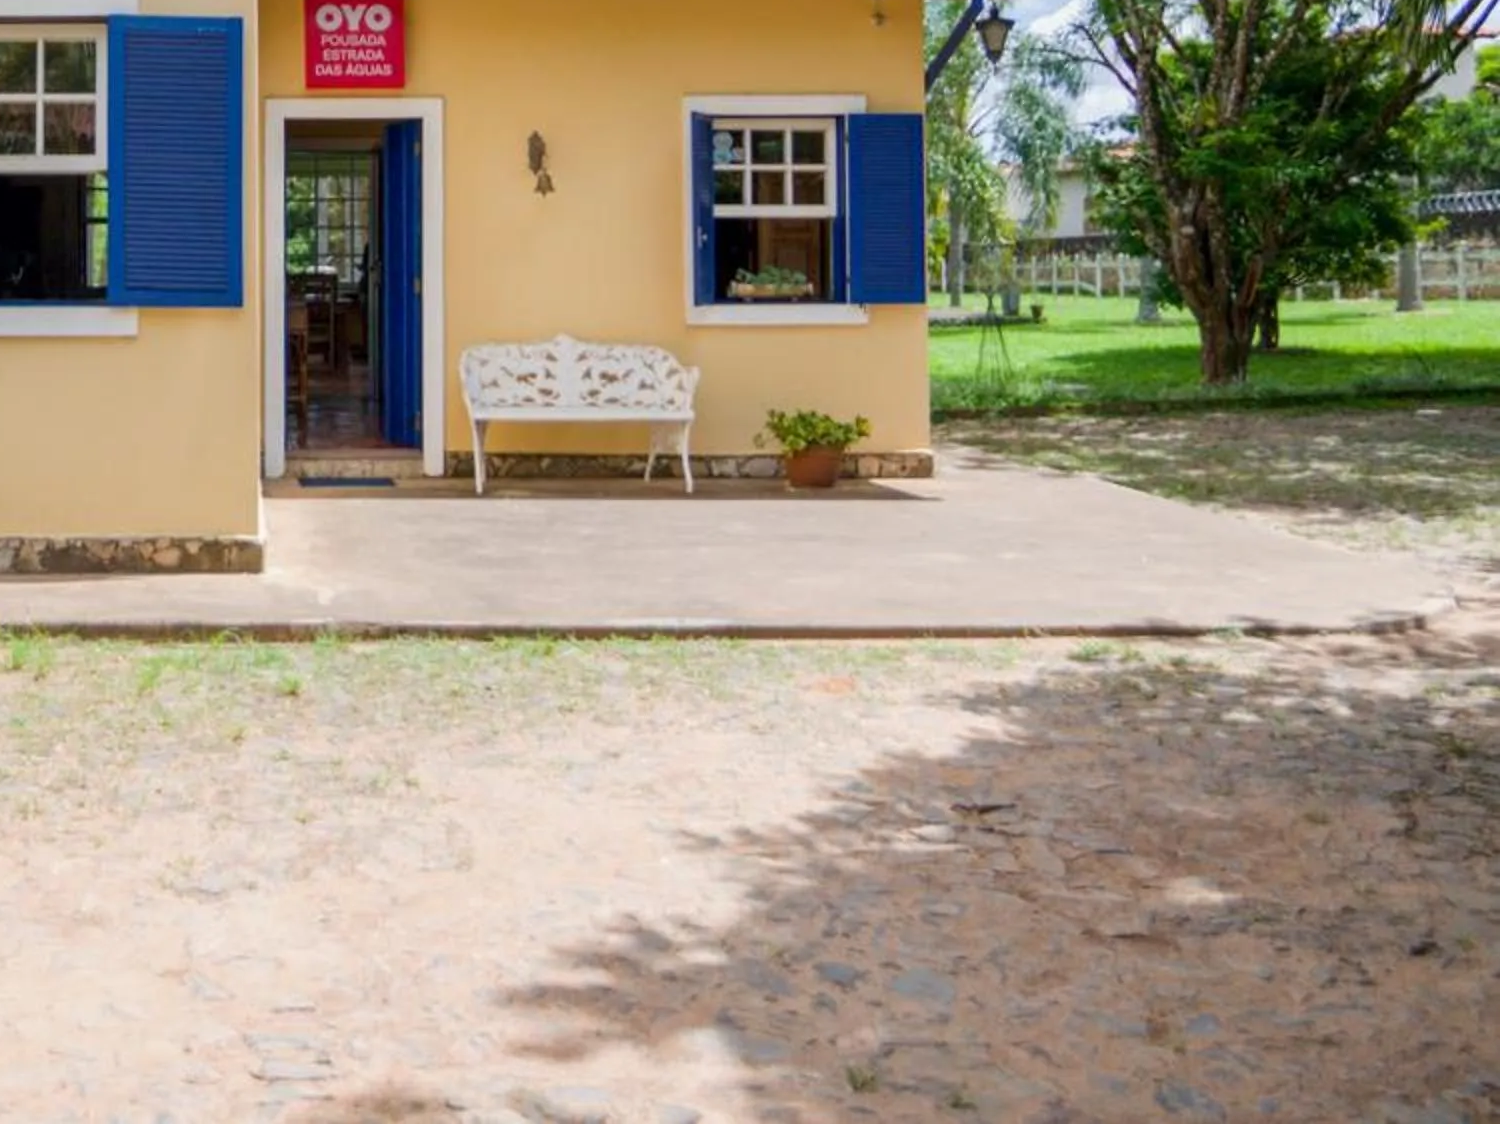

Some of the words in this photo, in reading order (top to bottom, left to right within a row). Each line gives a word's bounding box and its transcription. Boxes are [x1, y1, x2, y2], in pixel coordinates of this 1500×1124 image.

[315, 3, 392, 32] OYO
[320, 34, 387, 47] POUSADA
[322, 48, 385, 62] ESTRADA
[315, 64, 343, 77] DAS
